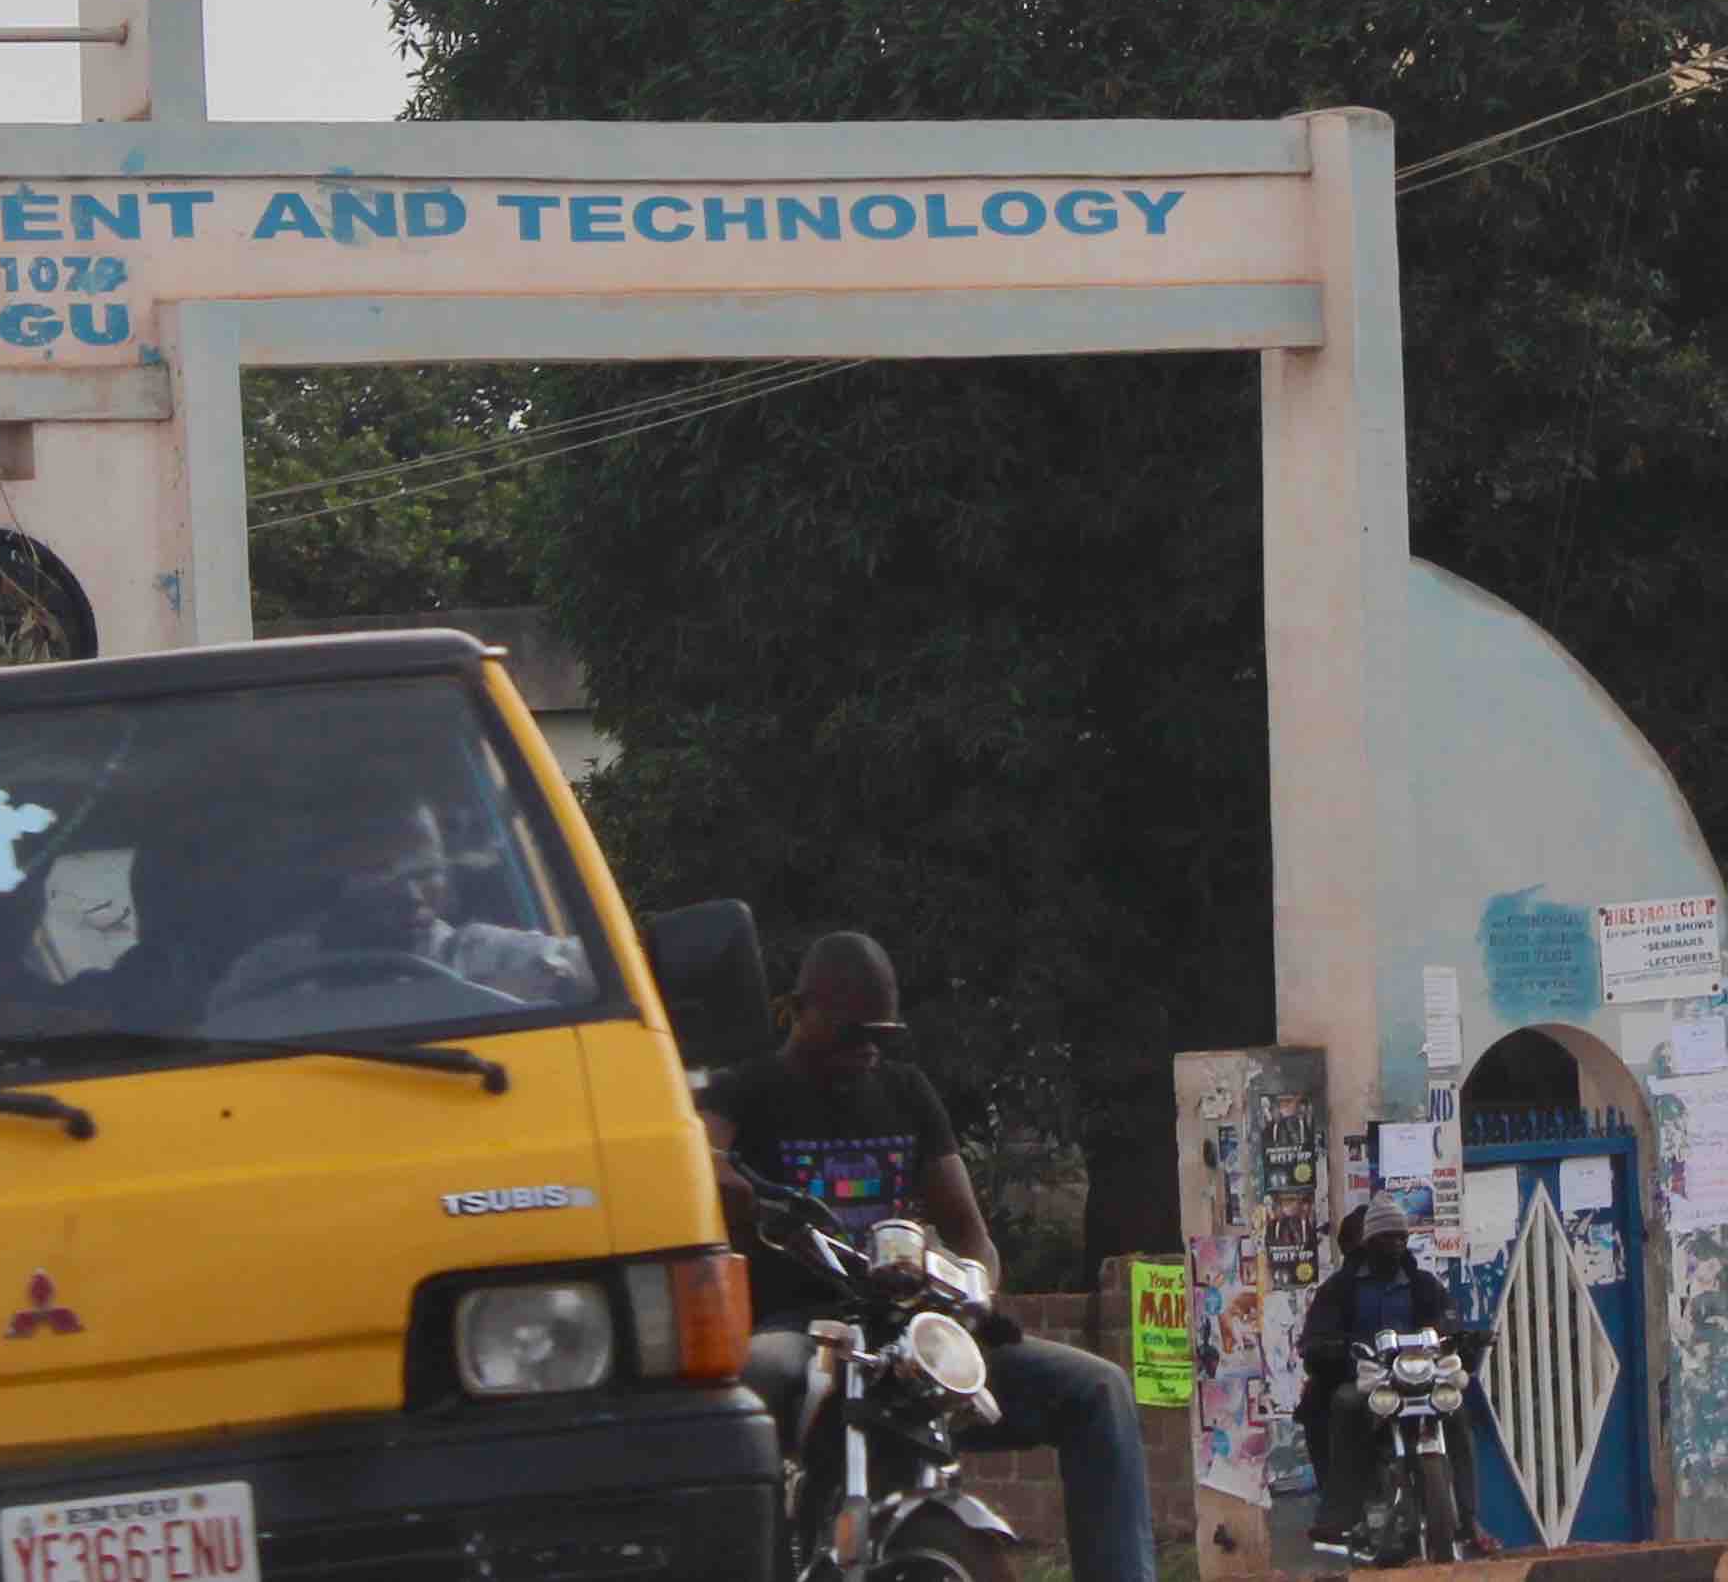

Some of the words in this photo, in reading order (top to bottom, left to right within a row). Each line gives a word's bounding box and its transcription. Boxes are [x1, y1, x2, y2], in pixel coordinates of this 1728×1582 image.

[252, 189, 468, 240] AND
[498, 189, 1185, 243] TECHNOLOGY
[1639, 898, 1717, 922] PROJECTR
[1675, 920, 1716, 933] SHOWS
[66, 1498, 180, 1525] ENUGU
